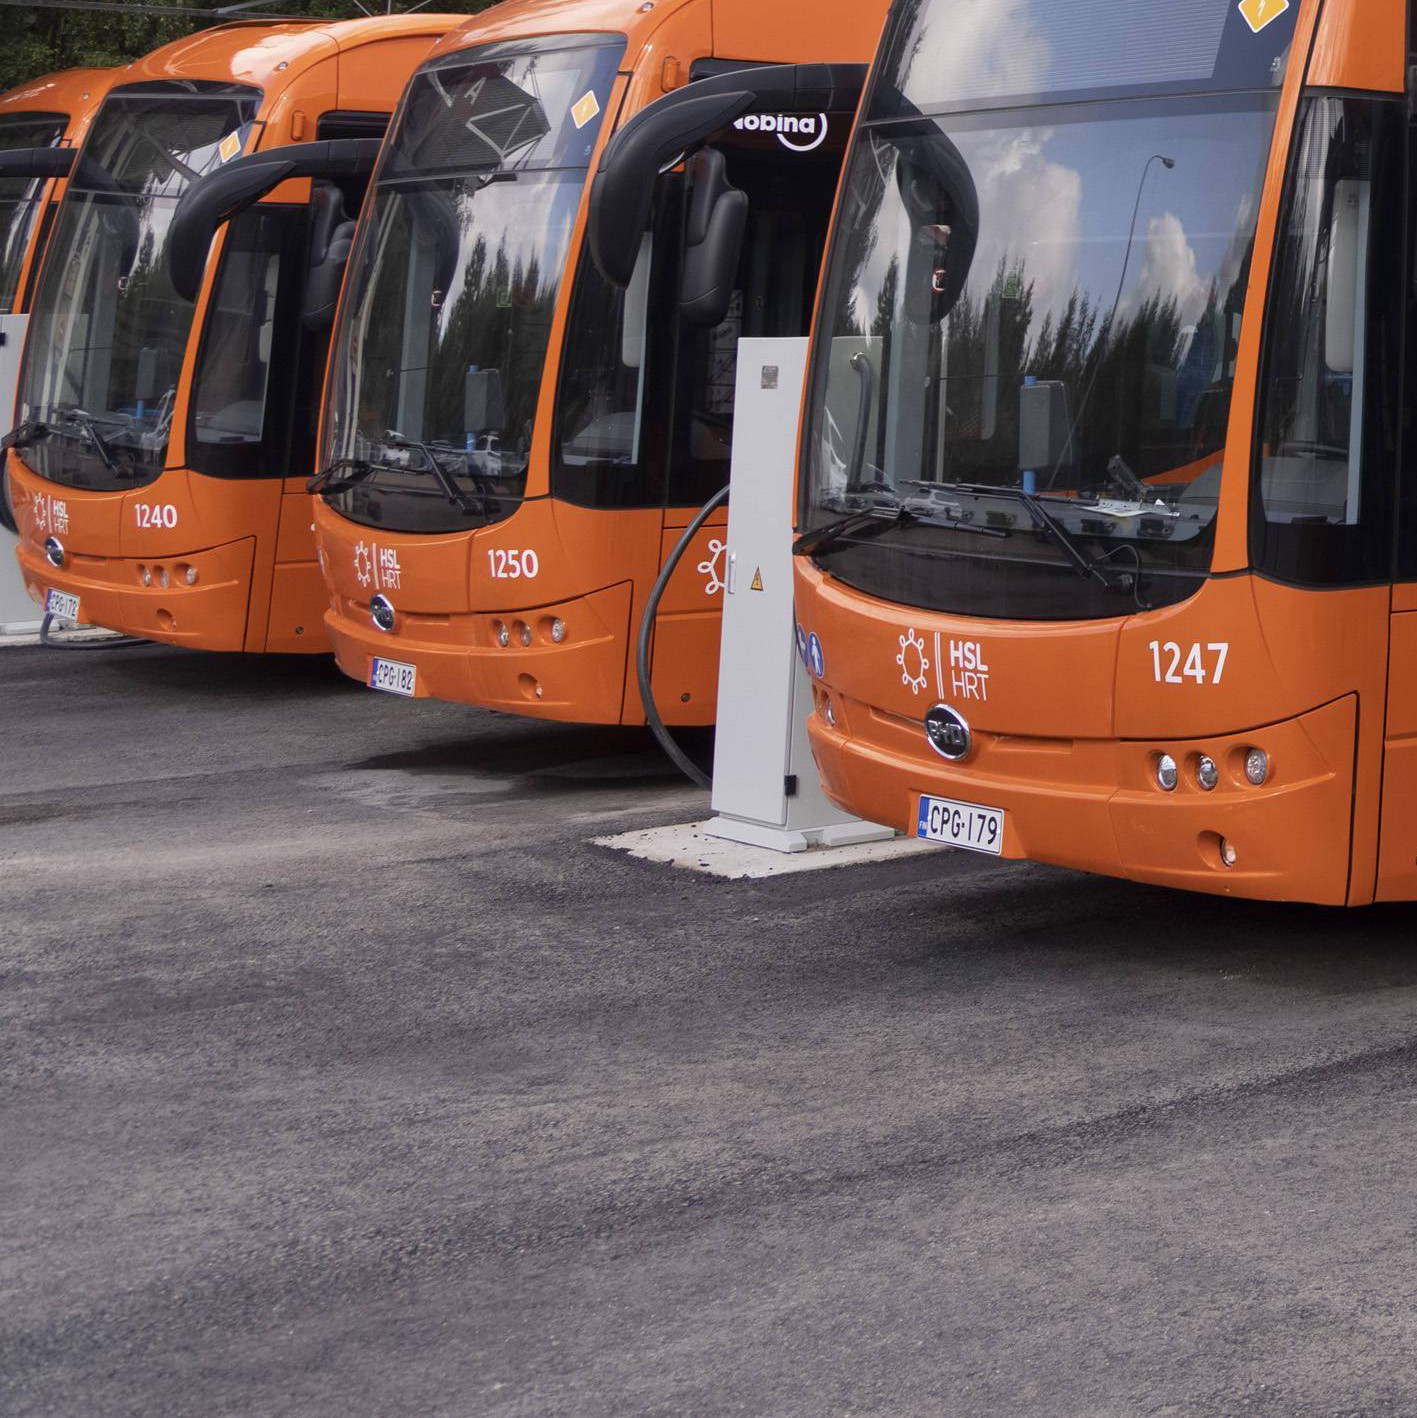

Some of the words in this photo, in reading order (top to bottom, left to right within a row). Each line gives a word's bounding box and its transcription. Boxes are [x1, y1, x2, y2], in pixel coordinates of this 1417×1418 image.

[53, 500, 69, 518] HSL
[134, 504, 177, 528] 1240
[379, 548, 401, 569] HSL
[488, 549, 539, 579] 1250
[381, 569, 401, 589] HRT
[949, 639, 989, 672] HSL
[1149, 641, 1229, 684] 1247
[952, 670, 989, 701] HRT
[928, 720, 964, 745] BYD
